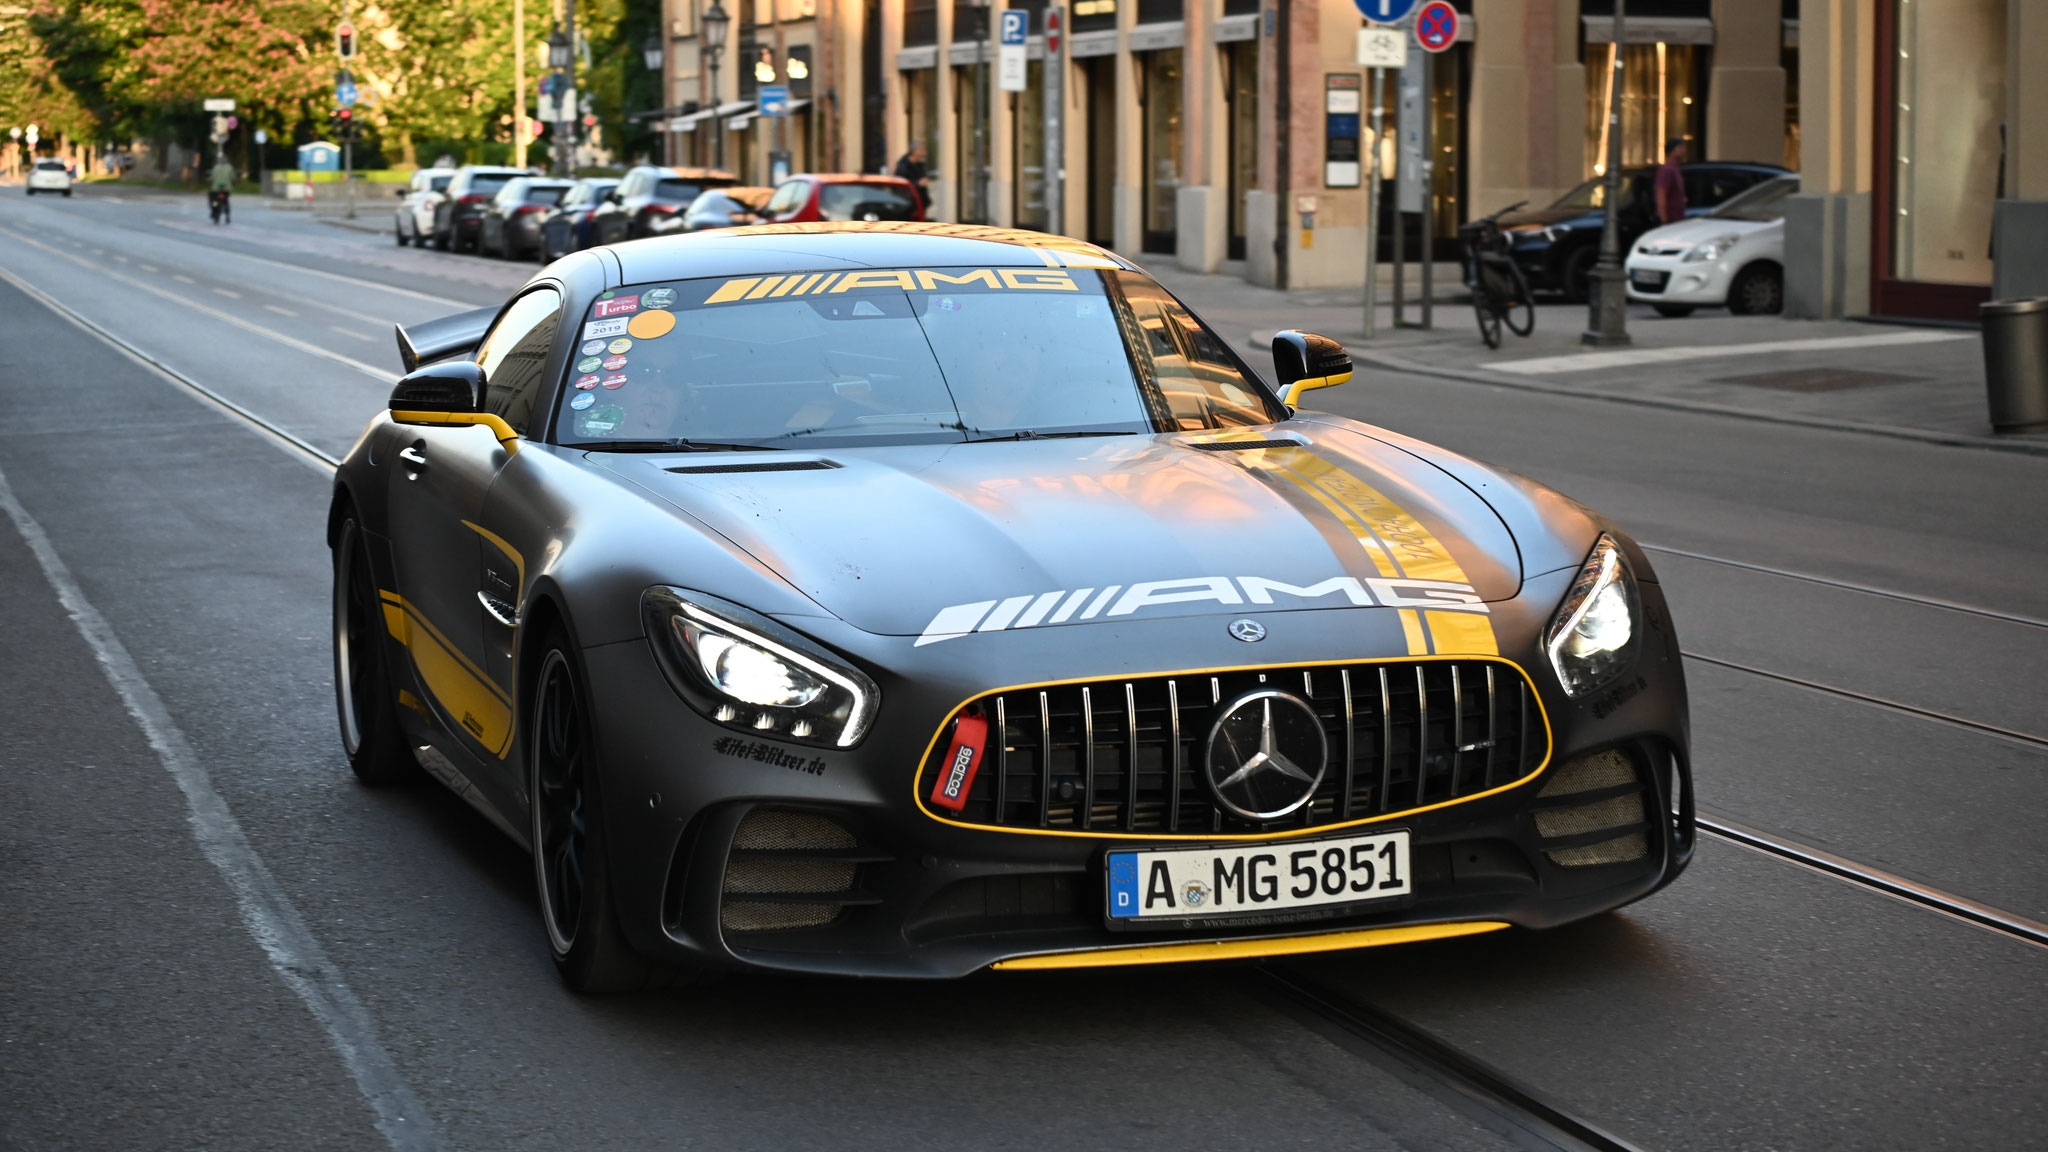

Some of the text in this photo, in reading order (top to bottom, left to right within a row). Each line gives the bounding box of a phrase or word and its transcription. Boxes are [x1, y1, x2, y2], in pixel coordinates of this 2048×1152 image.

[828, 268, 1080, 294] AMG
[592, 325, 621, 335] 2019
[1106, 576, 1490, 617] AMG
[946, 746, 973, 798] sparco
[1145, 841, 1403, 909] A MG 5851
[1118, 892, 1129, 906] D
